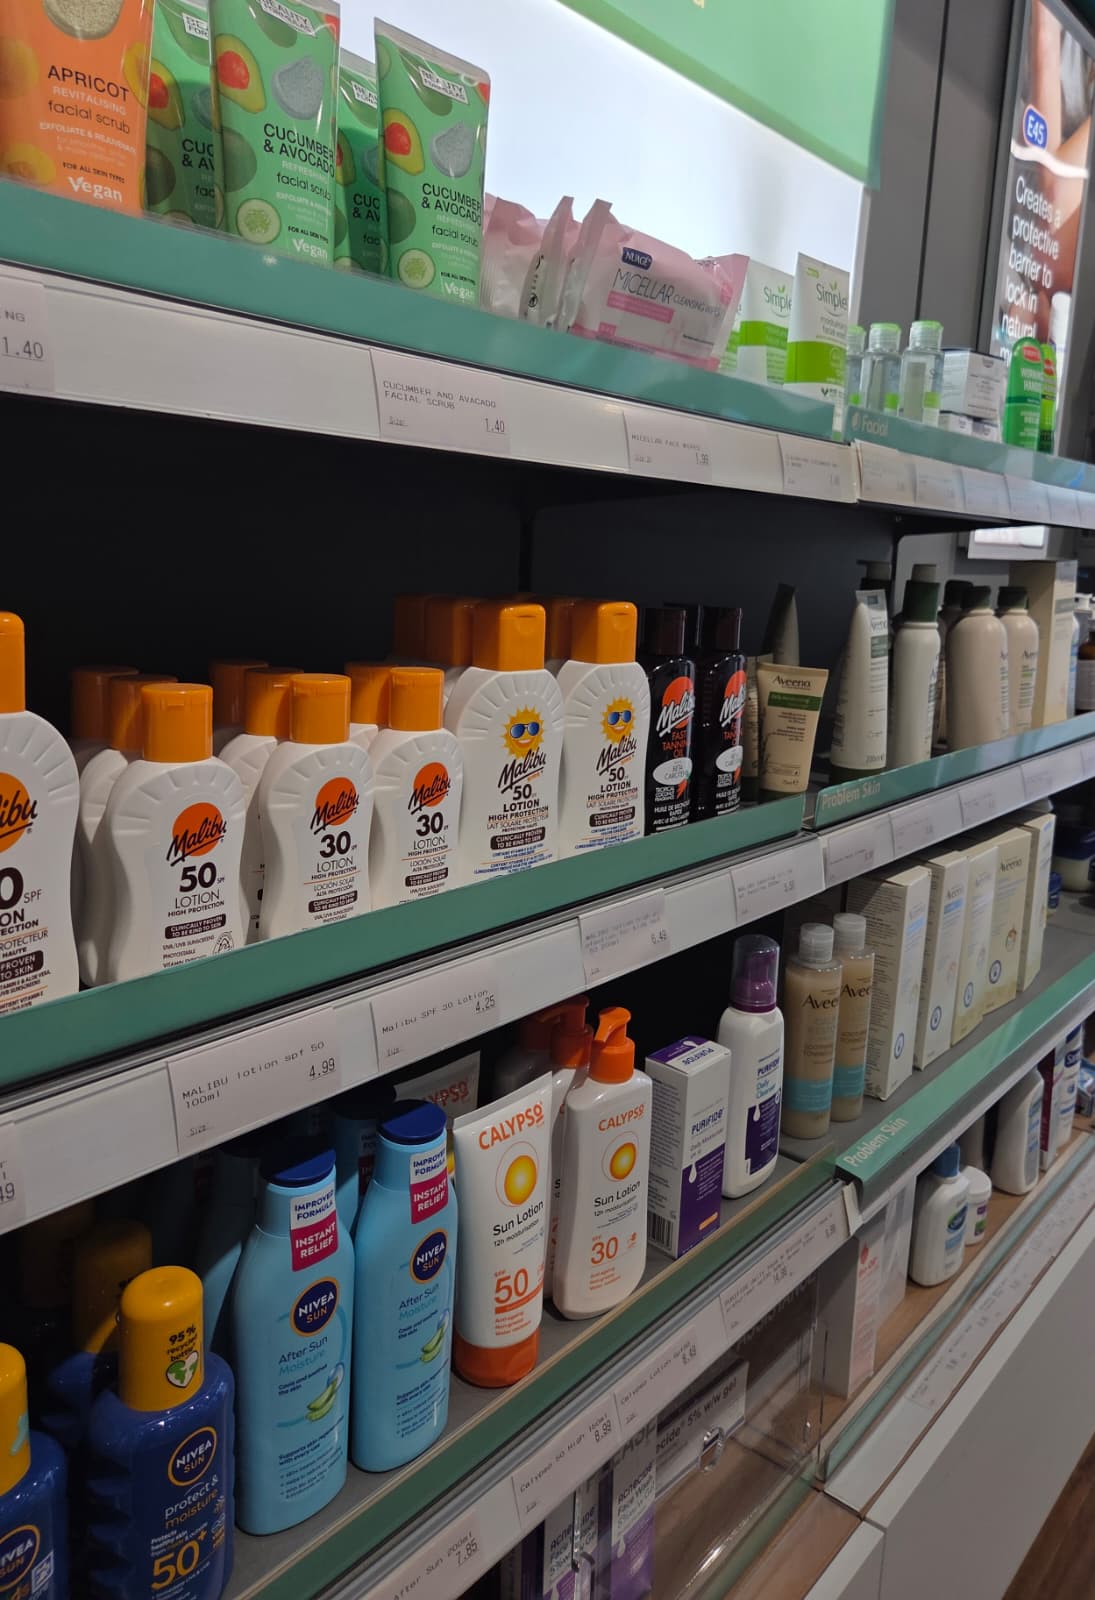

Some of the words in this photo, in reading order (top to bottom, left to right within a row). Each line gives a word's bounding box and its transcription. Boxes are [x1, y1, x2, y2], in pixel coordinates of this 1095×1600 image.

[47, 65, 129, 102] APRICOT
[52, 86, 126, 116] REVITALISING
[48, 100, 92, 121] facial
[95, 113, 130, 134] scrub
[1027, 114, 1044, 146] E45
[263, 123, 334, 160] CUCUMBER
[263, 139, 274, 154] &
[279, 143, 335, 178] AVOCADO
[62, 161, 77, 170] FOR
[80, 164, 92, 174] ALL
[92, 168, 108, 178] SKIN
[108, 173, 125, 184] TYPES
[277, 171, 309, 192] facial
[310, 183, 331, 200] scrub
[68, 175, 123, 203] Vegan
[422, 183, 481, 210] CUCUMBER
[1015, 176, 1053, 221] Creates
[1053, 209, 1061, 229] a
[352, 208, 361, 219] &
[422, 197, 430, 209] &
[434, 199, 482, 227] AVOCADO
[292, 238, 327, 260] Vegan
[431, 225, 458, 240] facial
[460, 231, 479, 248] scrub
[1012, 214, 1060, 260] protective
[1008, 247, 1040, 281] barrier
[1041, 261, 1052, 289] to
[613, 268, 674, 304] MICELLAR
[816, 283, 848, 311] Simple
[1005, 277, 1027, 307] lock
[1027, 292, 1038, 313] in
[1001, 314, 1037, 338] natural
[3, 336, 44, 360] 1.40
[383, 380, 431, 395] CUCUMBER
[437, 391, 454, 401] AND
[459, 395, 496, 408] AVACADO
[384, 390, 421, 404] FACIAL
[427, 398, 455, 409] SCRUB
[485, 417, 505, 433] 1.40
[861, 415, 889, 436] Facial
[773, 674, 811, 687] Aveeno
[596, 733, 637, 772] Malibu
[498, 747, 547, 790] Malibu
[608, 766, 625, 782] 50
[408, 774, 451, 812] Malibu
[512, 783, 533, 801] 50
[587, 793, 605, 801] HIGH
[606, 787, 639, 799] PROTECTION
[600, 780, 631, 793] LOTION
[821, 787, 860, 811] Problem
[862, 780, 880, 798] Skin
[310, 789, 359, 830] Malibu
[488, 812, 508, 822] HIGH
[510, 805, 549, 819] PROTECTION
[503, 799, 540, 813] LOTION
[416, 811, 443, 837] 30
[166, 814, 227, 863] Malibu
[319, 830, 351, 859] 30
[413, 835, 445, 851] LOTION
[316, 856, 354, 873] LOTION
[408, 849, 422, 857] HIGH
[179, 861, 217, 893] 50
[311, 873, 327, 881] HIGH
[327, 866, 357, 880] PROTECTION
[24, 888, 43, 904] SPF
[168, 909, 186, 918] HIGH
[188, 900, 224, 913] PROTECTION
[175, 889, 220, 909] LOTION
[170, 921, 202, 932] CLINICALLY
[202, 916, 223, 927] PROVEN
[2, 947, 27, 959] HAUTE
[0, 971, 12, 980] TO
[14, 964, 34, 977] SKIN
[382, 1016, 417, 1034] Malibu
[442, 1001, 454, 1011] 30
[458, 989, 489, 1006] Lotion
[475, 994, 496, 1012] 4.25
[182, 1077, 229, 1100] MALIBU
[237, 1059, 279, 1080] lotion
[284, 1049, 304, 1062] spf
[310, 1040, 325, 1052] 50
[186, 1090, 221, 1110] 100ml
[308, 1057, 336, 1080] 4.99
[478, 1103, 543, 1150] CALYPSO
[598, 1103, 645, 1132] CALYPSO
[843, 1129, 888, 1168] Problem
[884, 1114, 910, 1139] Skin
[415, 1159, 447, 1177] FORMULA
[294, 1189, 335, 1213] IMPROVED
[413, 1179, 448, 1203] INSTANT
[418, 1190, 446, 1212] RELIEF
[594, 1194, 614, 1207] Sun
[616, 1180, 640, 1200] Lotion
[296, 1200, 334, 1222] FORMULA
[493, 1219, 514, 1236] Sun
[516, 1201, 544, 1224] Lotion
[295, 1221, 336, 1248] INSTANT
[300, 1234, 334, 1259] RELIEF
[494, 1236, 505, 1247] 12h
[416, 1242, 446, 1266] NIVEA
[591, 1236, 618, 1264] 30
[422, 1256, 440, 1272] SUN
[399, 1294, 423, 1310] After
[424, 1283, 439, 1298] Sun
[494, 1268, 529, 1304] 50
[298, 1291, 335, 1317] NIVEA
[307, 1305, 328, 1324] SUN
[279, 1347, 308, 1364] After
[308, 1335, 328, 1352] Sun
[279, 1349, 325, 1377] Moisture
[703, 1392, 722, 1411] w/w
[722, 1377, 738, 1401] gel
[594, 1419, 612, 1444] 8.99
[175, 1439, 212, 1469] NIVEA
[184, 1455, 205, 1473] SUN
[165, 1482, 210, 1520] protect
[211, 1474, 219, 1486] &
[165, 1489, 218, 1529] moisture
